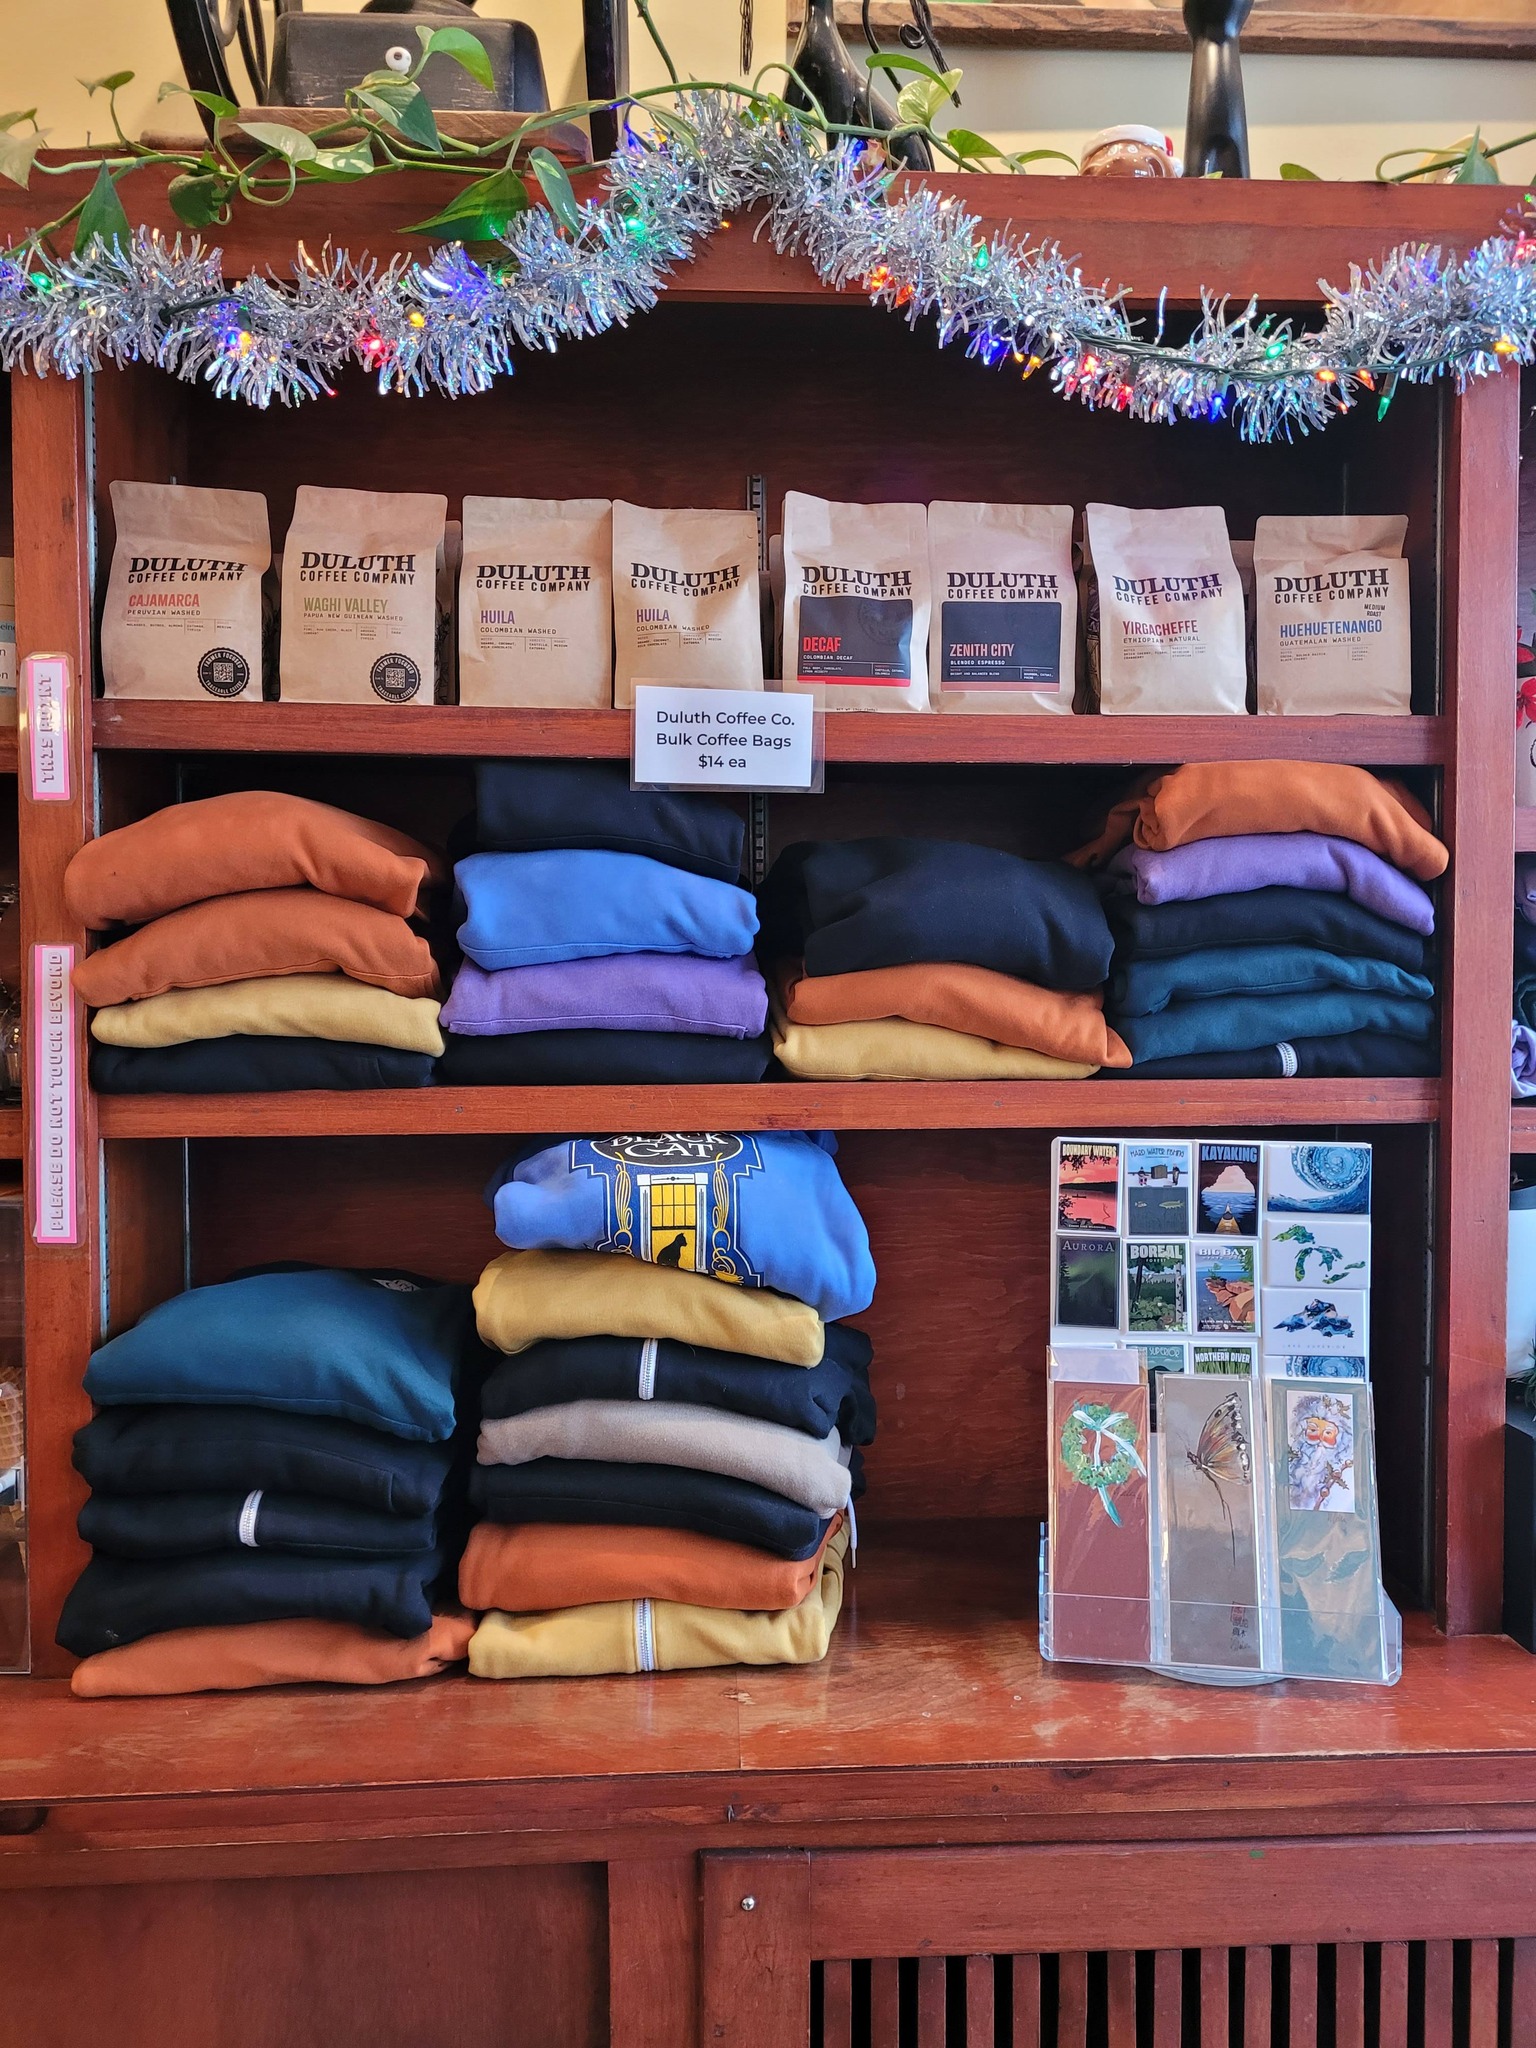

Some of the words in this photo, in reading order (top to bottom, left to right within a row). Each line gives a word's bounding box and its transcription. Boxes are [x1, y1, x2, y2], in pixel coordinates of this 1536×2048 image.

[129, 557, 248, 572] DULUTH
[300, 552, 416, 572] DULUTH
[128, 572, 175, 583] COFFEE
[182, 571, 242, 581] COMPANY
[300, 570, 348, 582] COFFEE
[354, 570, 415, 585] COMPANY
[476, 564, 591, 581] DULUTH
[631, 562, 740, 587] DULUTH
[801, 565, 912, 587] DULUTH
[947, 572, 1058, 588] DULUTH
[1274, 568, 1389, 592] DULUTH
[476, 579, 525, 590] COFFEE
[531, 580, 590, 592] COMPANY
[631, 578, 677, 594] COFFEE
[683, 578, 740, 597] COMPANY
[803, 583, 849, 595] COFFEE
[854, 584, 912, 597] COMPANY
[1112, 573, 1222, 595] DULUTH
[129, 593, 200, 607] CAJAMARCA
[948, 588, 994, 599] COFFEE
[1001, 588, 1058, 599] COMPANY
[1116, 591, 1159, 605] COFFEE
[1165, 588, 1223, 602] COMPANY
[1275, 592, 1322, 604] COFFEE
[1329, 587, 1389, 600] COMPANY
[303, 597, 341, 612] WAGHI
[344, 598, 389, 614] VALLEY
[480, 610, 515, 624] HUILA
[636, 608, 670, 623] HUILA
[636, 624, 677, 632] COLOMBIAN
[1123, 620, 1198, 636] YIRGACHEFFE
[1280, 619, 1382, 638] HUEHUETENANGO
[803, 636, 841, 652] DECAF
[950, 643, 988, 656] ZENITH
[991, 643, 1015, 656] CITY
[1279, 638, 1327, 646] GUATEMALAN
[37, 673, 54, 732] POINT
[656, 711, 711, 724] Duluth
[716, 711, 766, 725] Coffee
[771, 713, 795, 726] Co.
[656, 733, 692, 746] Bulk
[697, 733, 748, 746] Coffee
[752, 735, 792, 750] Bags
[39, 738, 55, 784] THIS
[698, 754, 724, 769] $14
[728, 758, 746, 768] ea
[48, 951, 63, 1025] BEYOND
[49, 1030, 63, 1089] TOUCH
[49, 1092, 63, 1129] NOT
[49, 1134, 63, 1158] DO
[624, 1142, 713, 1157] CAT
[1062, 1144, 1091, 1156] BOUNDARY
[1092, 1145, 1117, 1158] WATERS
[1202, 1145, 1258, 1163] KAYAKING
[49, 1163, 64, 1231] PLEASE
[1062, 1240, 1114, 1252] AURORA
[1130, 1244, 1182, 1259] BOREAL
[1199, 1248, 1220, 1256] BIG
[1223, 1248, 1248, 1256] BAY
[1149, 1347, 1180, 1357] SUPERIOR
[1194, 1352, 1229, 1363] NORTHERN
[1231, 1353, 1250, 1363] DIVER
